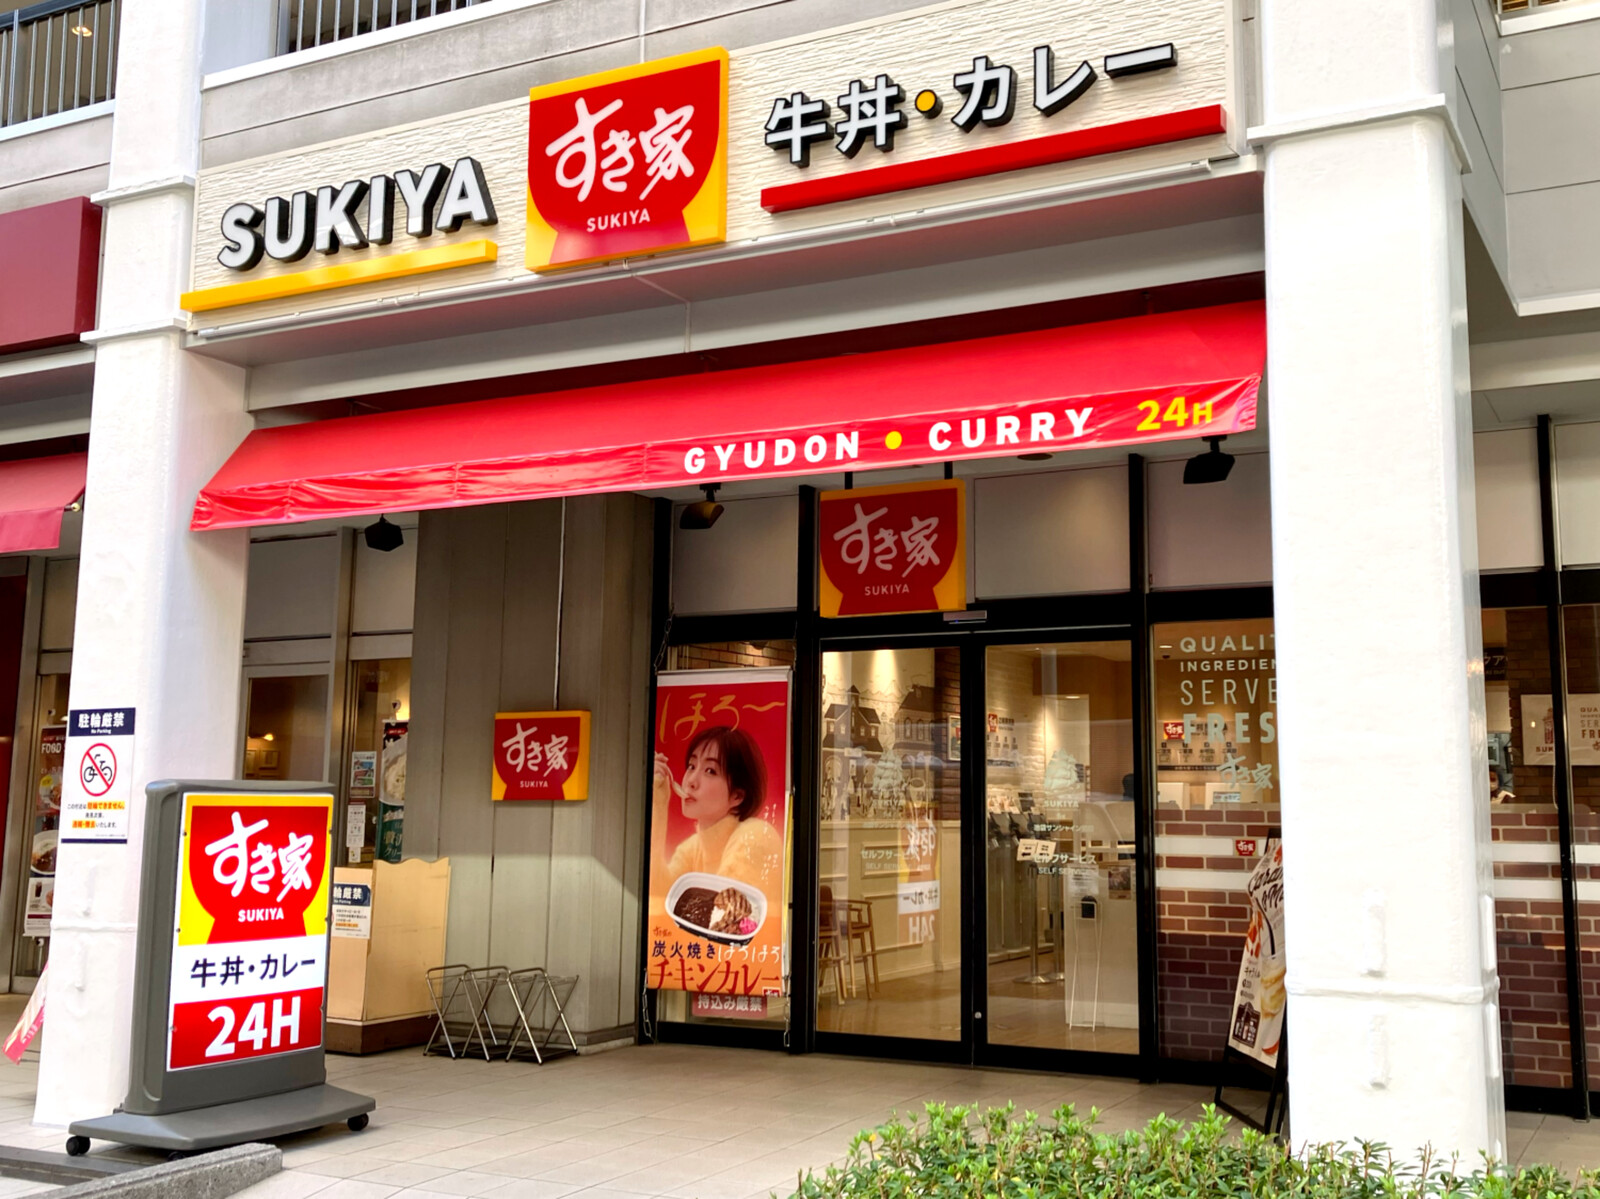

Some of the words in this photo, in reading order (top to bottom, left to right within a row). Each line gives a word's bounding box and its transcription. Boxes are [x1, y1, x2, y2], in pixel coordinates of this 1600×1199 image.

[765, 43, 1177, 167] 牛丼・カレー
[545, 97, 694, 202] すき家
[217, 156, 497, 272] SUKIYA
[586, 208, 650, 232] SUKIYA
[684, 431, 859, 474] GYUDON
[928, 407, 1093, 451] CURRY
[1136, 396, 1213, 431] 24H
[833, 503, 940, 578] すき家
[864, 583, 910, 596] SUKIYA
[1180, 633, 1275, 653] QUALI
[78, 711, 125, 729] 駐輪厳禁
[502, 722, 569, 777] すき家
[520, 780, 549, 788] SUKIYA
[1215, 753, 1274, 792] すき家
[204, 811, 314, 902] すき家
[237, 907, 285, 923] SUKIYA
[190, 953, 316, 988] 牛丼・カレー
[650, 958, 780, 995] チキンカレー
[697, 994, 763, 1012] 持込み厳禁
[204, 996, 301, 1058] 24H
